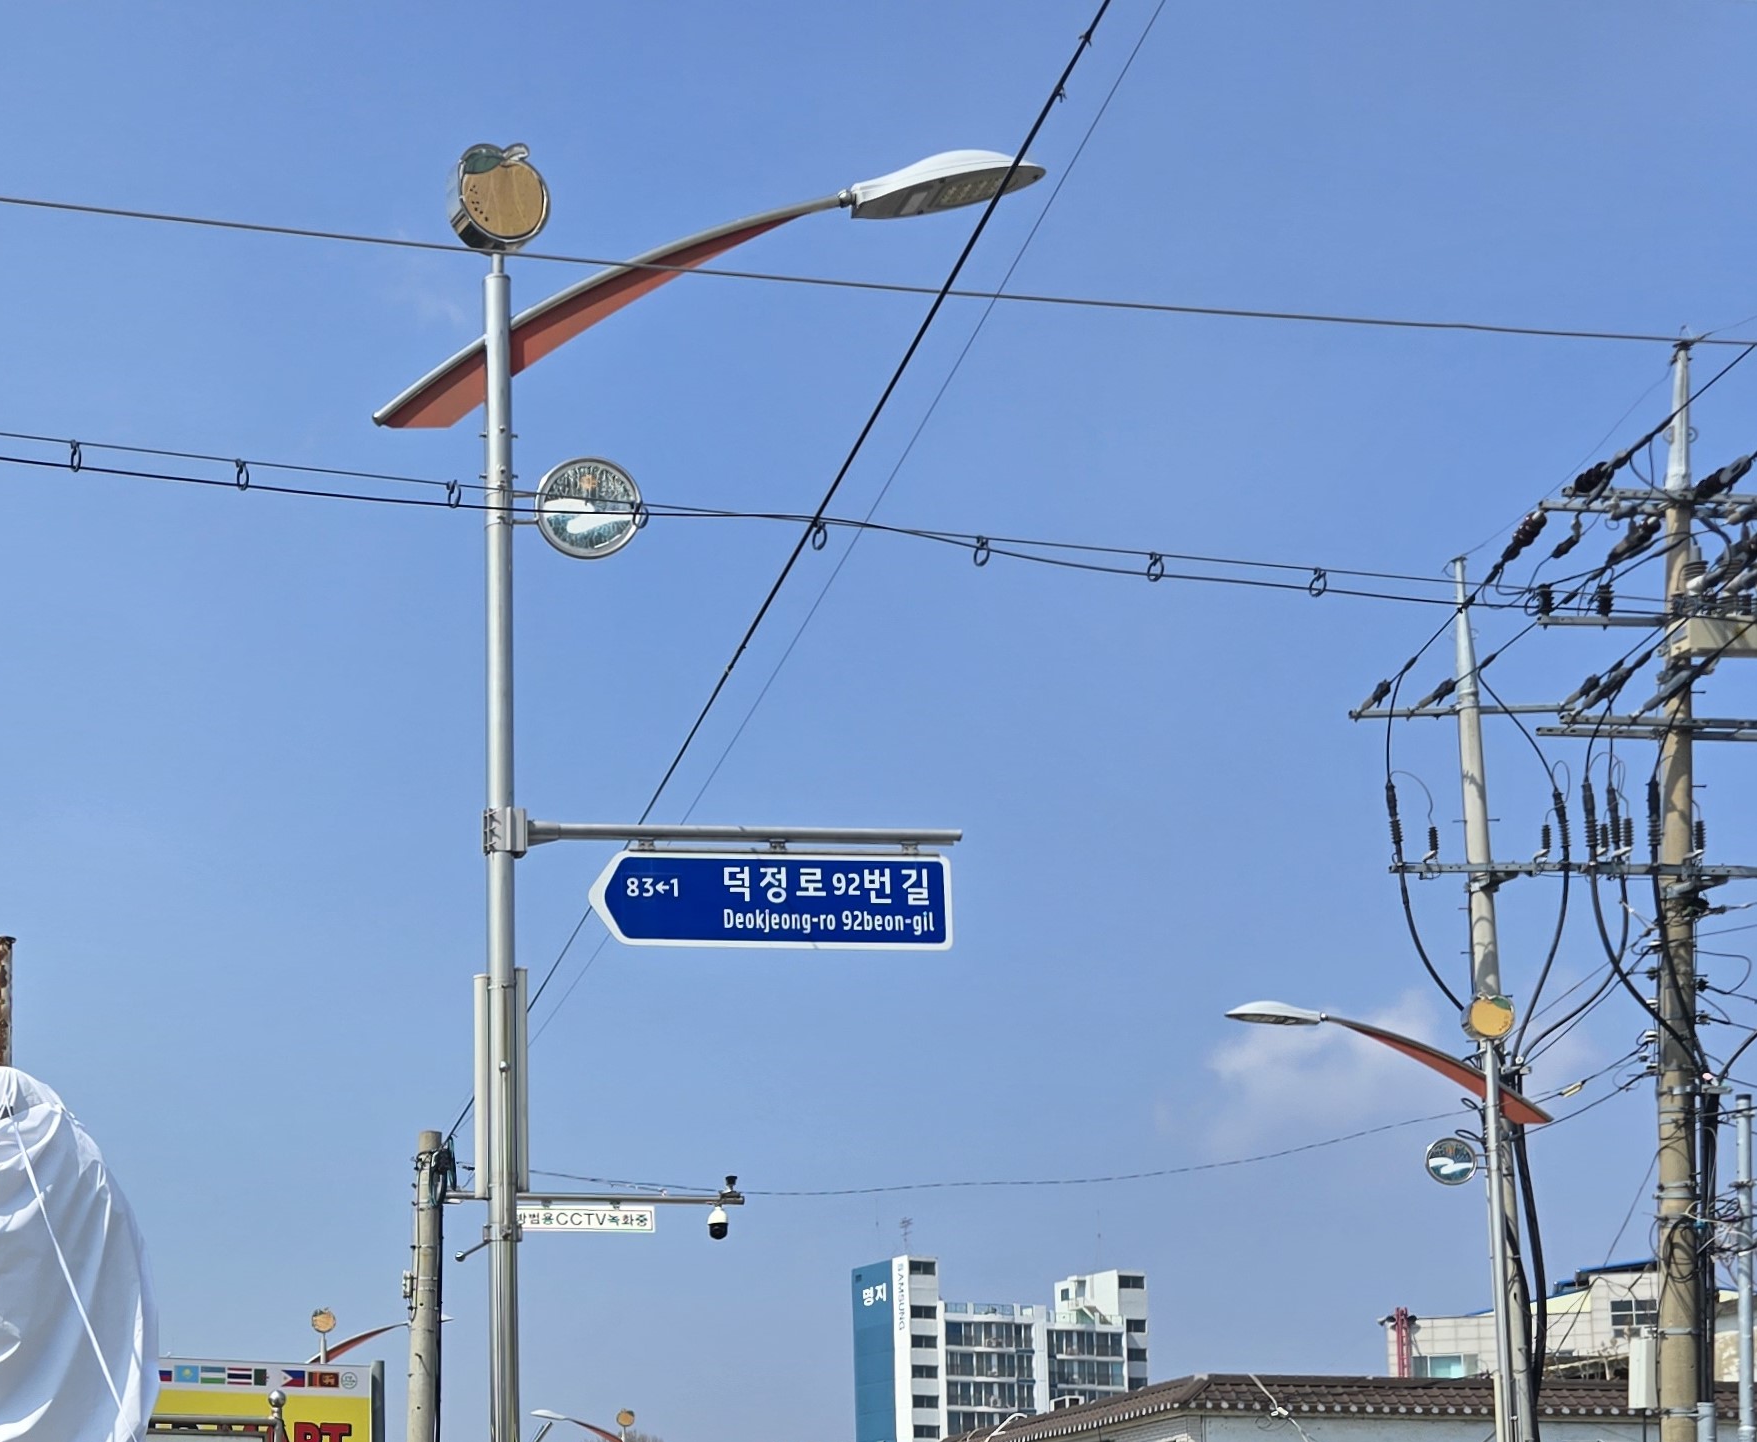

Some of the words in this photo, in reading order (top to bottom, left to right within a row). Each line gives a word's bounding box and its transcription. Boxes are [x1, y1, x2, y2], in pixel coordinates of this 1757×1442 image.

[723, 909, 835, 933] Deokjeong-ro
[842, 910, 935, 935] 92beon-gil
[862, 1282, 887, 1307] 명지
